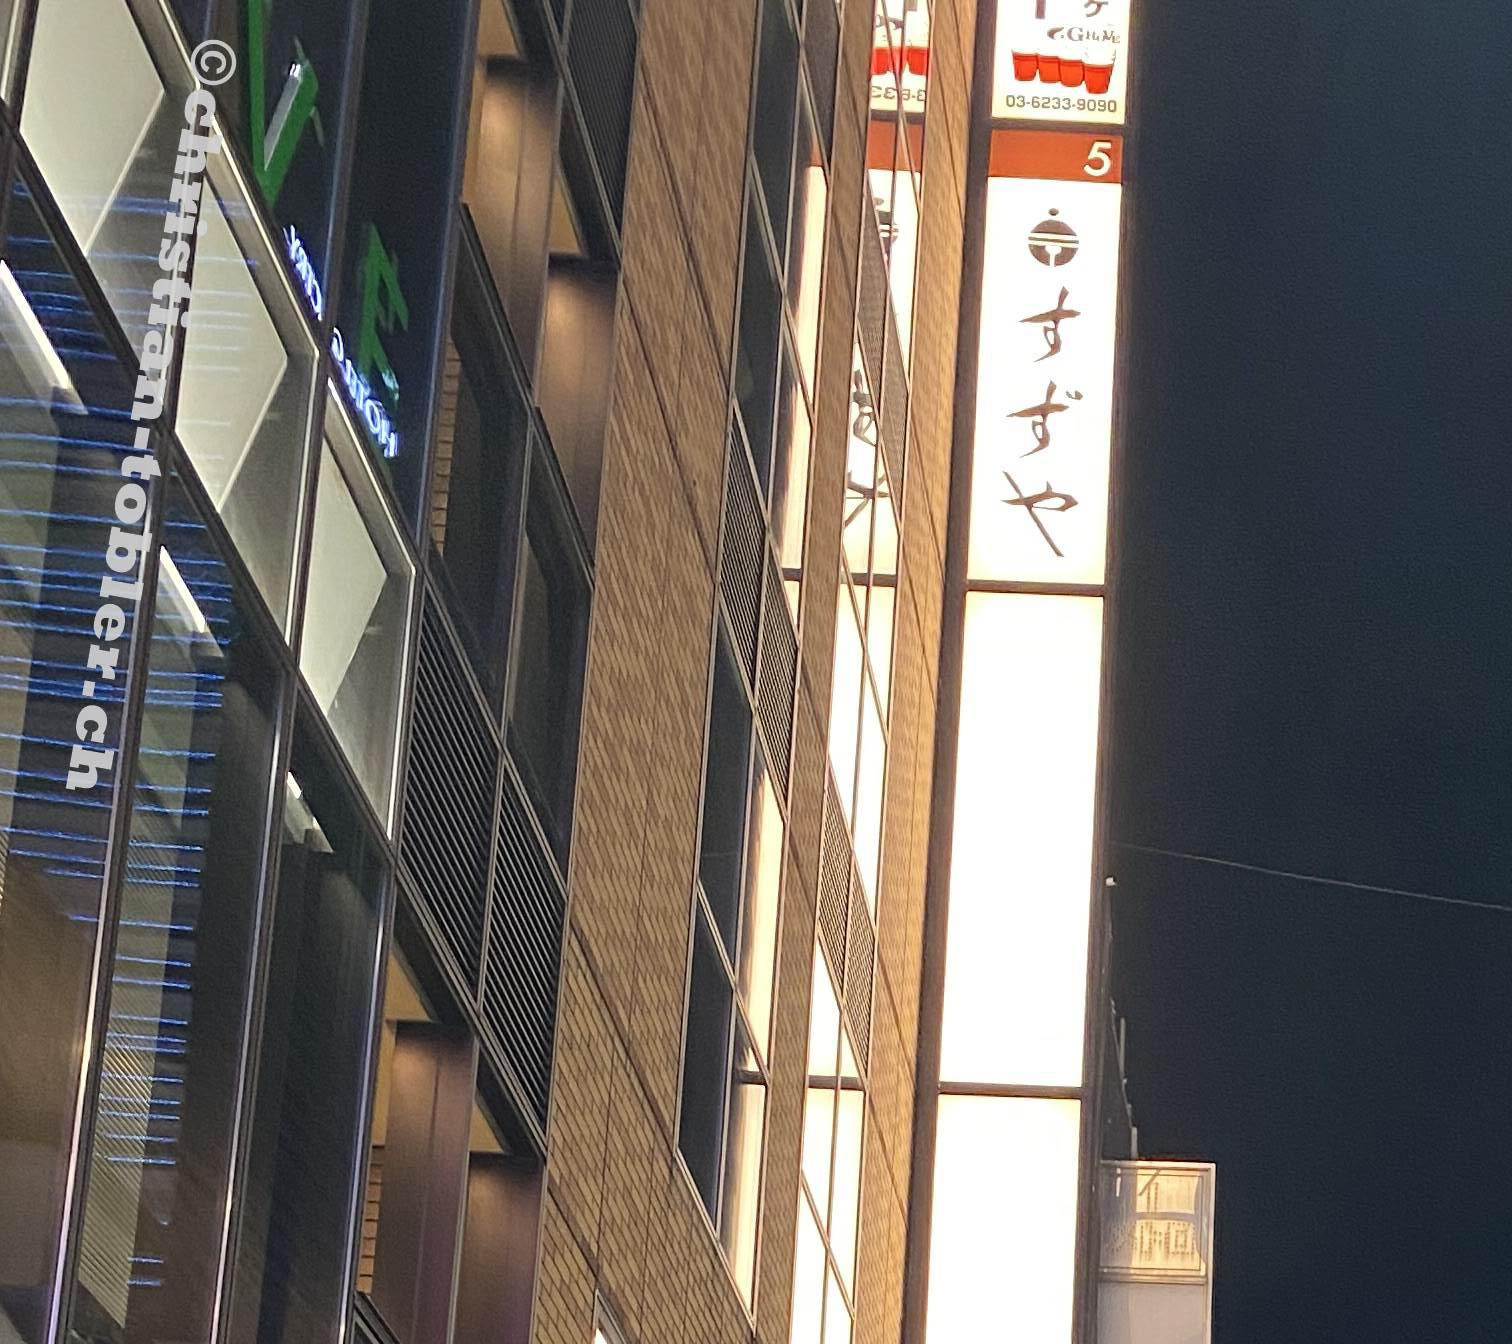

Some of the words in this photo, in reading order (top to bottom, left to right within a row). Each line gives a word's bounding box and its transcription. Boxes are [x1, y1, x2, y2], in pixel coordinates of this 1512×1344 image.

[1006, 94, 1117, 112] 03-6233-9090
[1083, 140, 1112, 177] 5
[1001, 286, 1083, 558] すずや
